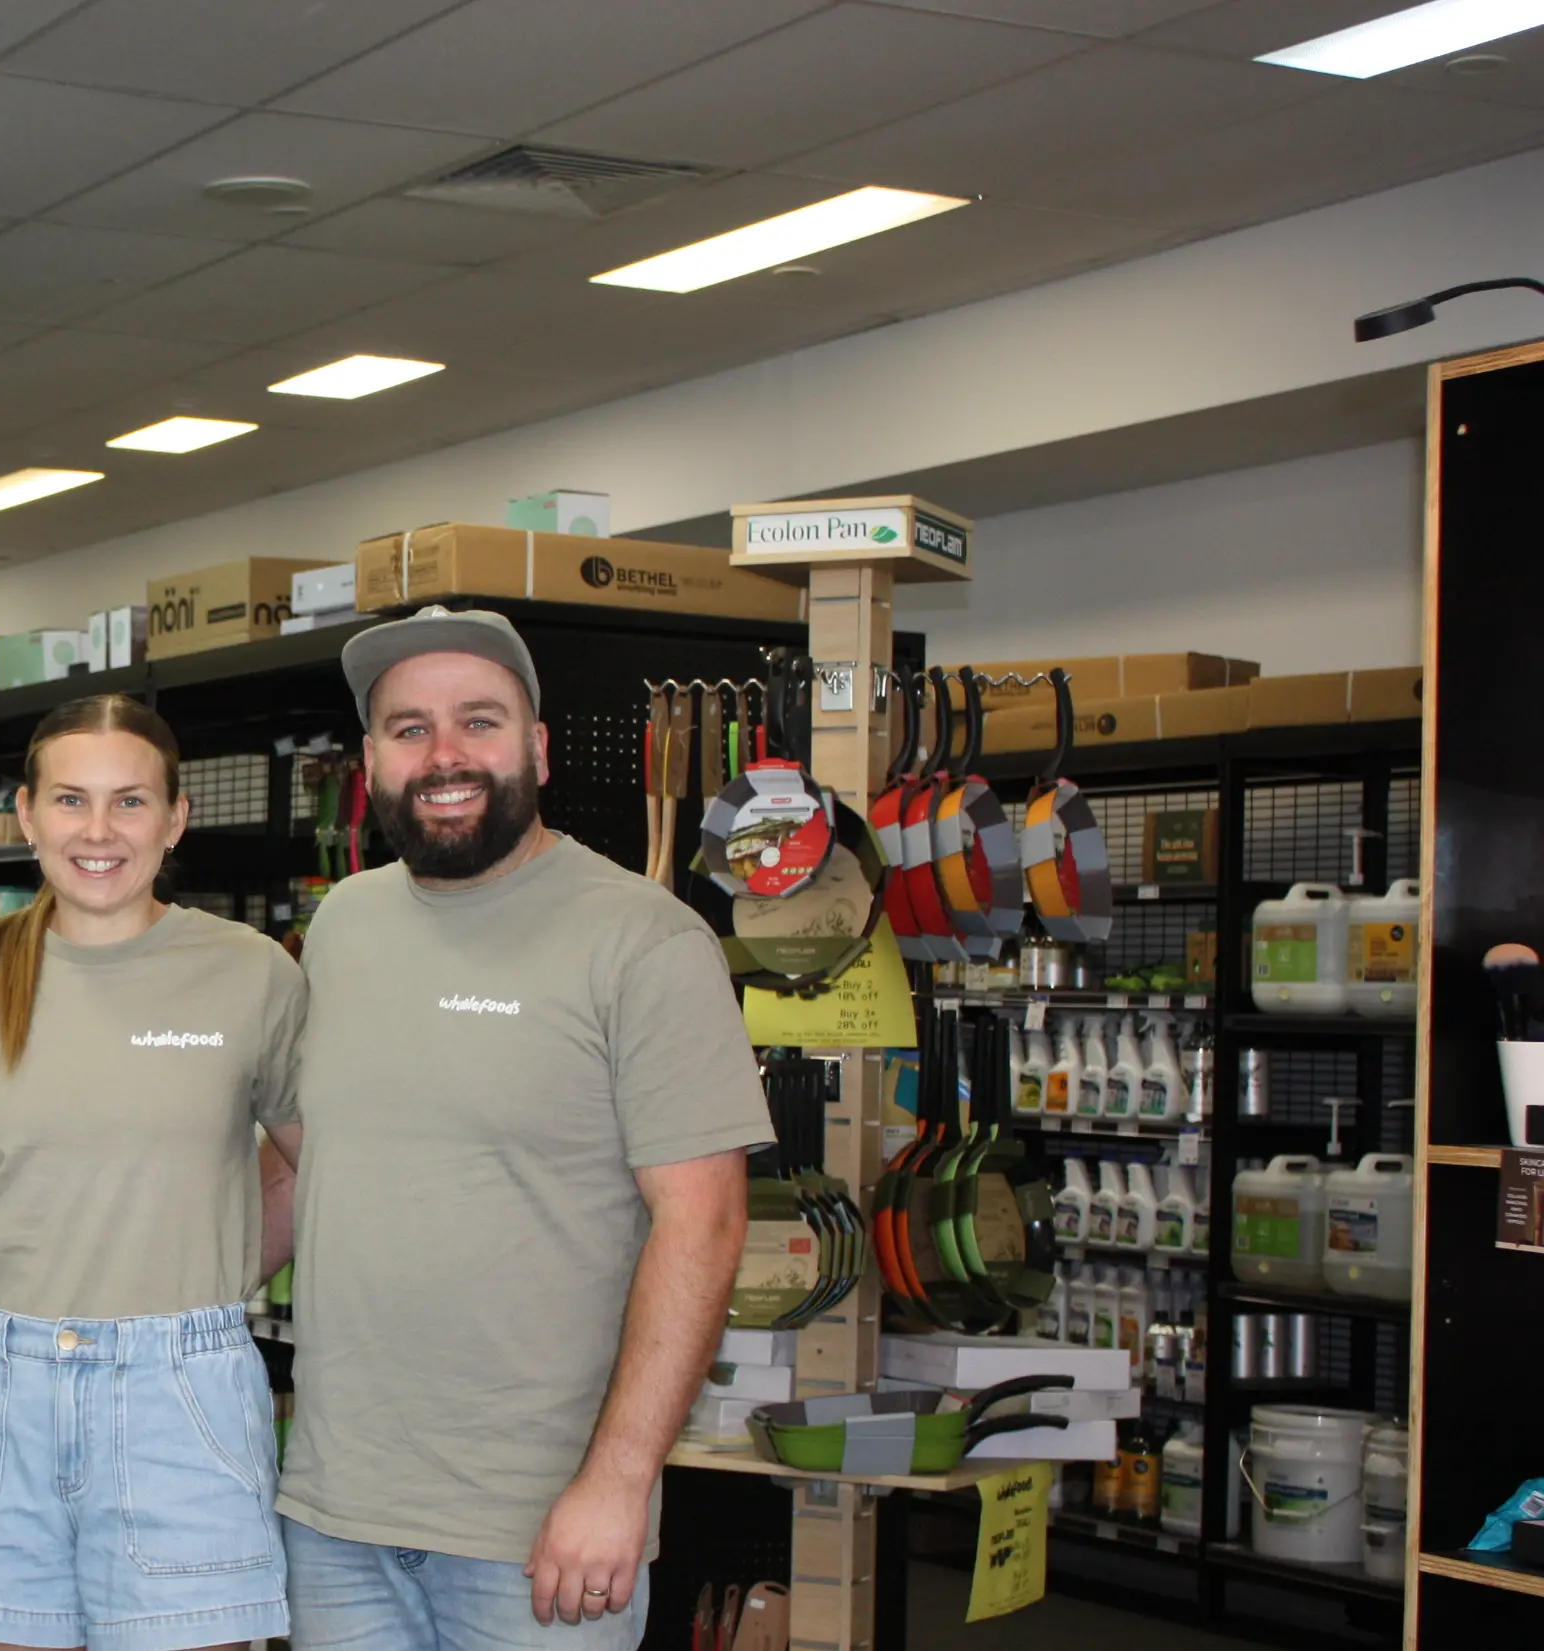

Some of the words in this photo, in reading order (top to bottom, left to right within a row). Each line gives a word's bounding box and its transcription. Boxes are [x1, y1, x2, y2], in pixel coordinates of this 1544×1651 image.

[747, 519, 819, 543] Ecolon
[826, 517, 868, 539] Pan
[616, 567, 677, 588] BETHEL
[842, 980, 861, 990] Buy
[866, 980, 873, 989] 2
[861, 991, 879, 1001] off
[840, 1010, 859, 1020] Buy
[861, 1020, 879, 1030] off
[1521, 1167, 1536, 1176] FOR
